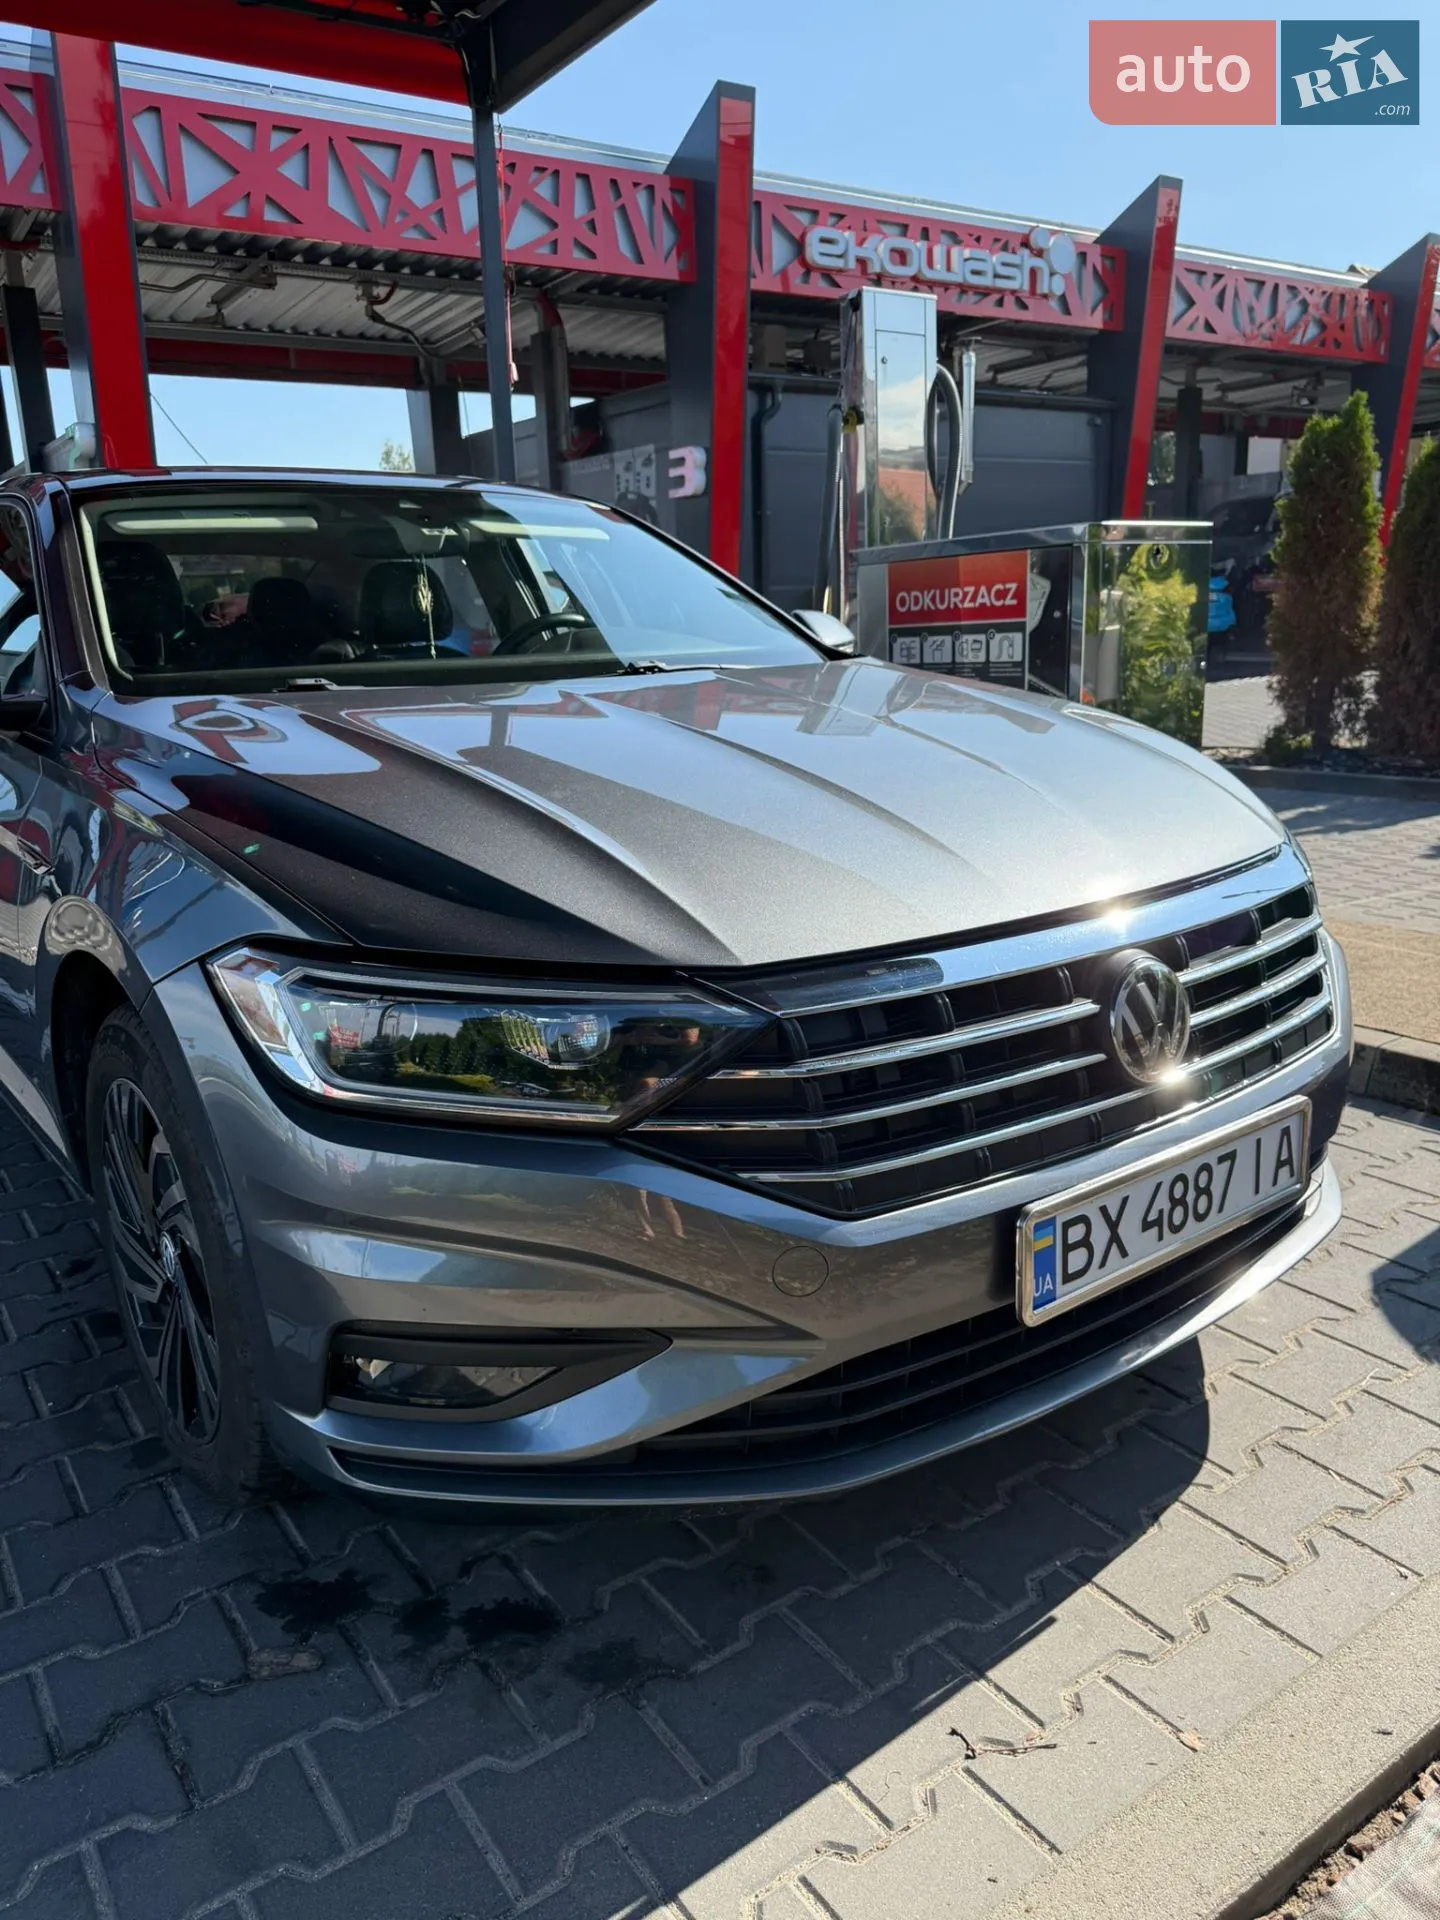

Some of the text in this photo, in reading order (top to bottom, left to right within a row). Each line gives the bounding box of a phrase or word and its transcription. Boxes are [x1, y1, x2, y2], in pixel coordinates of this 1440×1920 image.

[804, 226, 1051, 296] ekowash
[667, 446, 707, 500] 3
[895, 582, 1018, 613] ODKURZACZ
[1060, 1125, 1296, 1286] BX 4887 IA
[1032, 1272, 1054, 1297] UA
